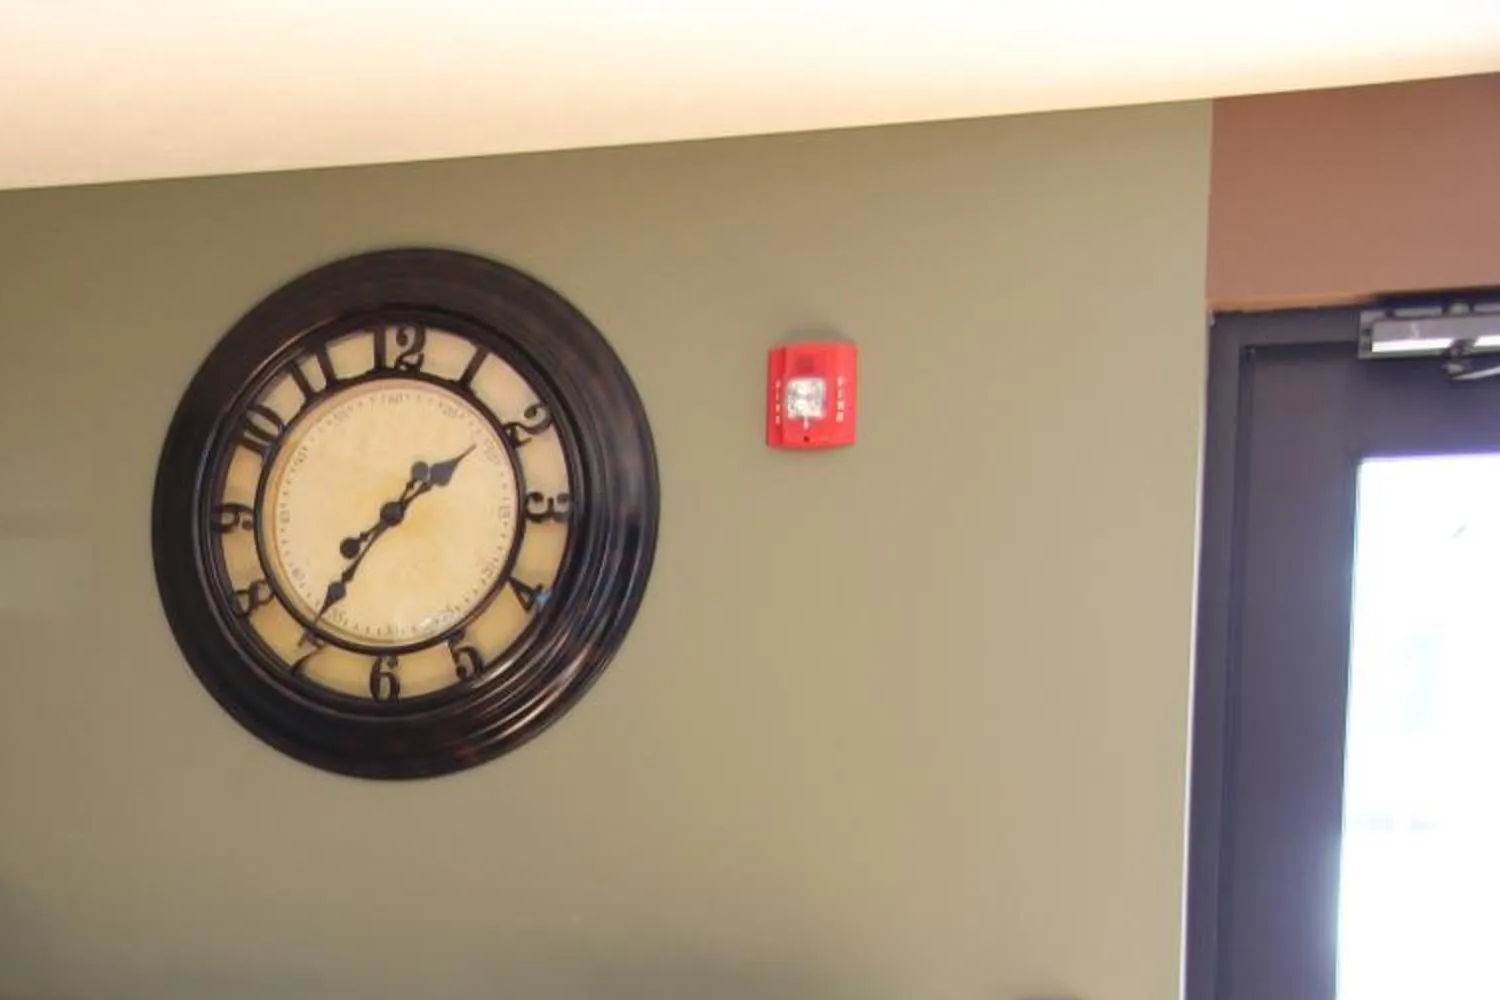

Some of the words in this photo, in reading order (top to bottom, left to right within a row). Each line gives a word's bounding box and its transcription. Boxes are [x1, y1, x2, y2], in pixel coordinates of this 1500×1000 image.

[372, 321, 426, 374] 12
[458, 345, 490, 388] 1
[238, 403, 284, 459] 10
[501, 401, 554, 448] 2
[209, 502, 255, 534] 9
[525, 490, 570, 524] 3
[231, 577, 275, 618] 8
[507, 575, 550, 614] 4
[290, 627, 327, 675] 7
[447, 628, 485, 682] 5
[368, 652, 401, 703] 6
